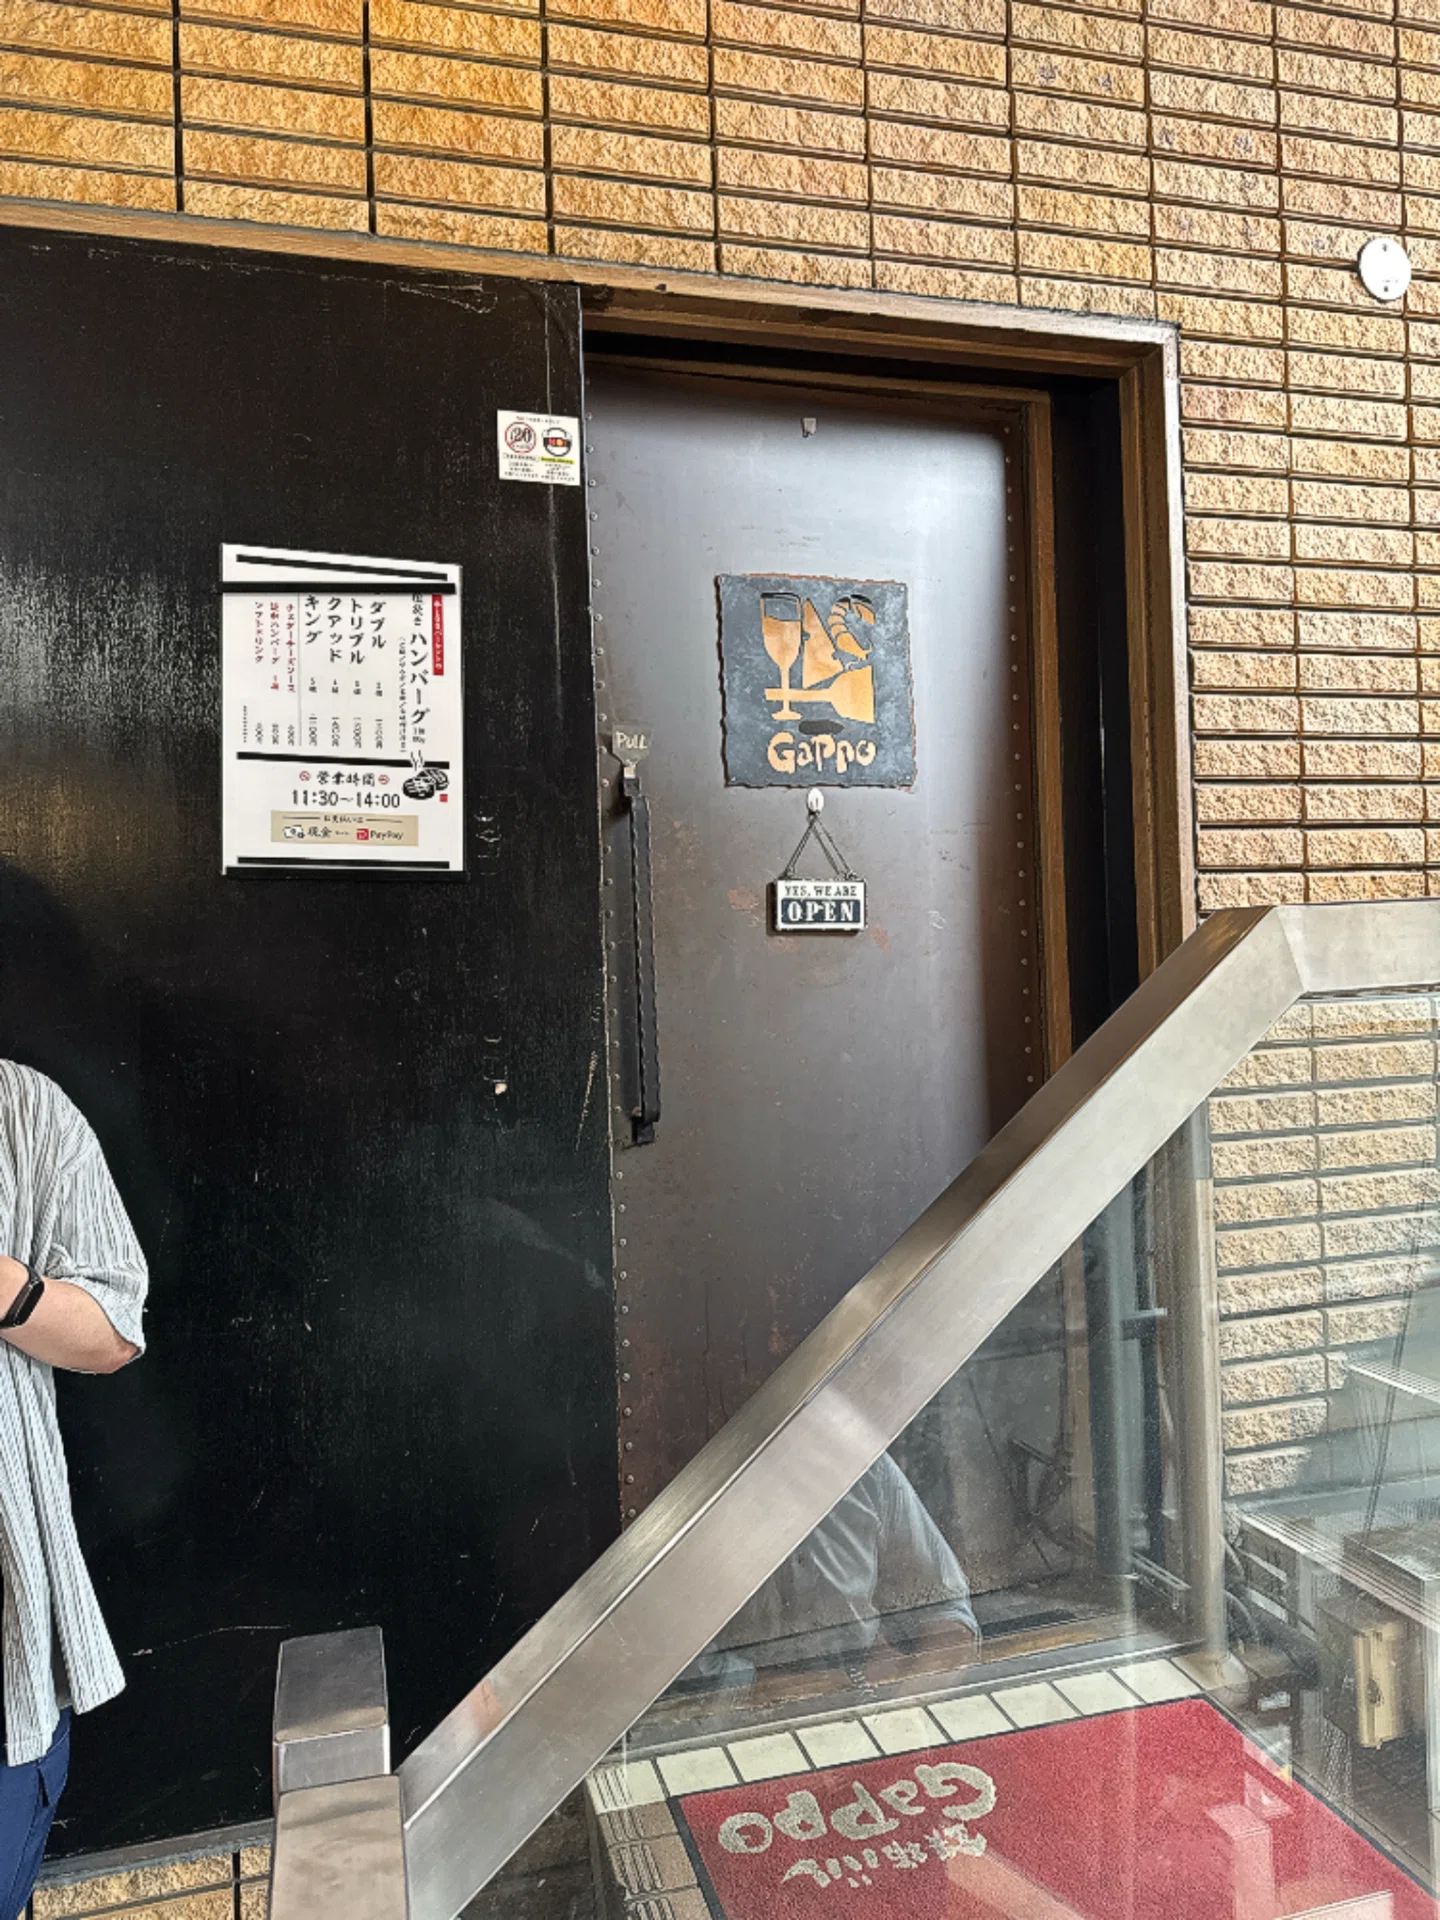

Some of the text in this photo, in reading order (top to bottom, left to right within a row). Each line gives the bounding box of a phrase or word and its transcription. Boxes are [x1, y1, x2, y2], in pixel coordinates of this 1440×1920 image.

[304, 594, 323, 645] キング
[328, 597, 343, 663] クアッド
[370, 601, 387, 649] ダブル
[410, 633, 430, 724] ハンバーグ
[316, 770, 376, 787] 営業時間
[307, 825, 332, 839] 現金
[370, 829, 404, 841] PayPay
[814, 885, 832, 897] WE
[834, 885, 857, 897] ARE
[787, 900, 855, 922] OPEN
